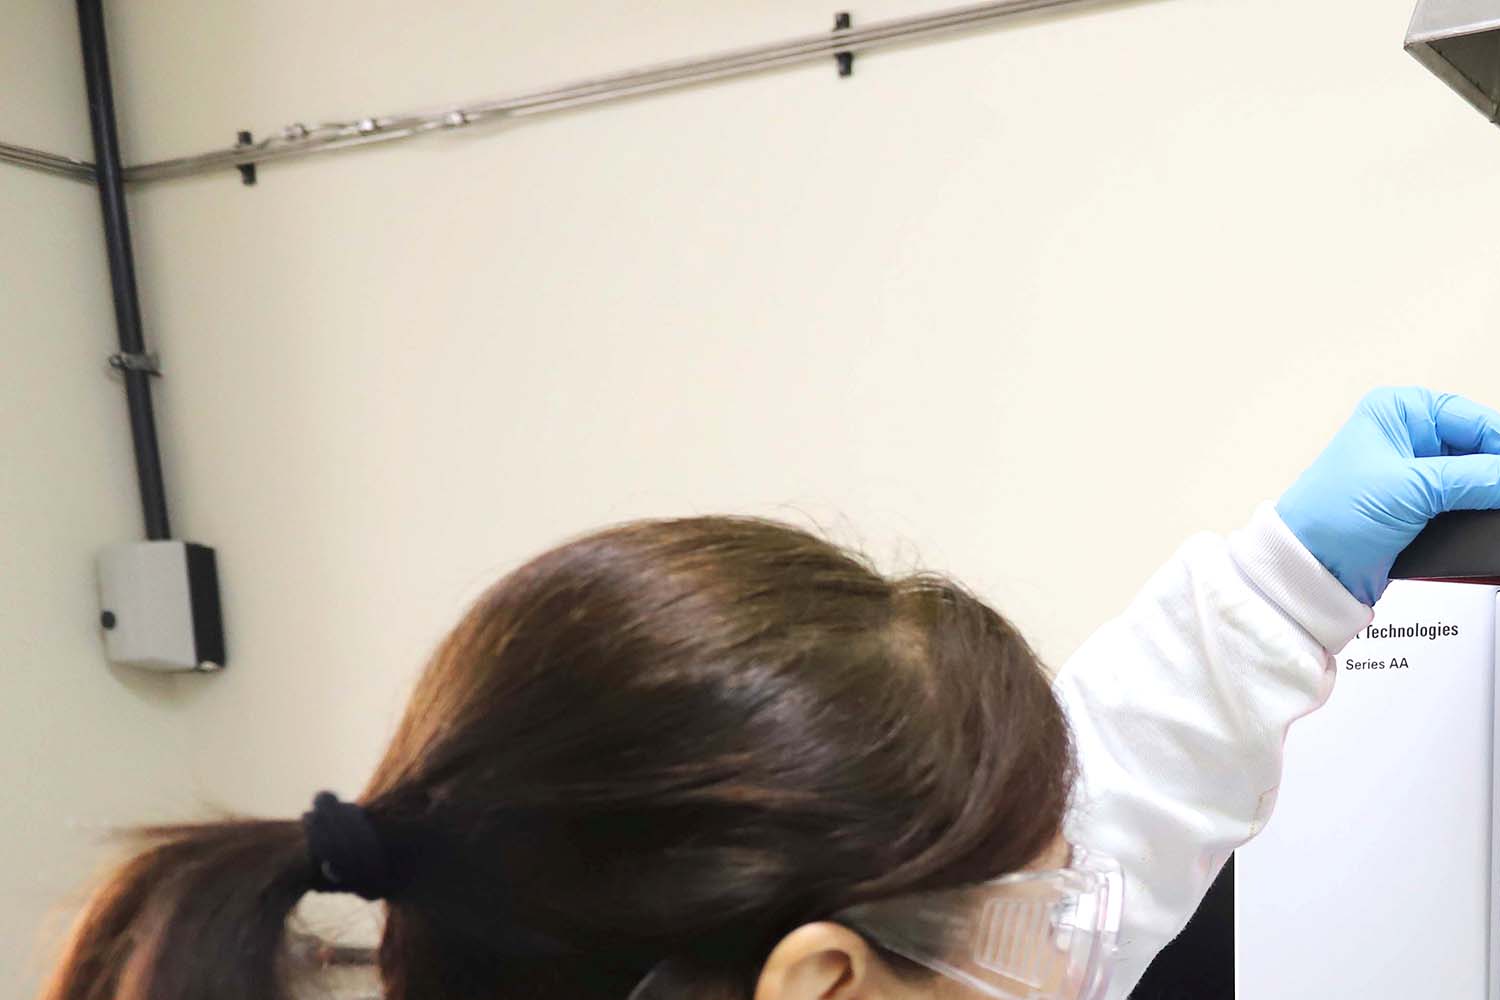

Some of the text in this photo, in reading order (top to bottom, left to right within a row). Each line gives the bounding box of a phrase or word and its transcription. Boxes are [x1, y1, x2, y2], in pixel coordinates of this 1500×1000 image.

[1366, 621, 1459, 640] Technologies
[1346, 657, 1409, 670] Series AA
